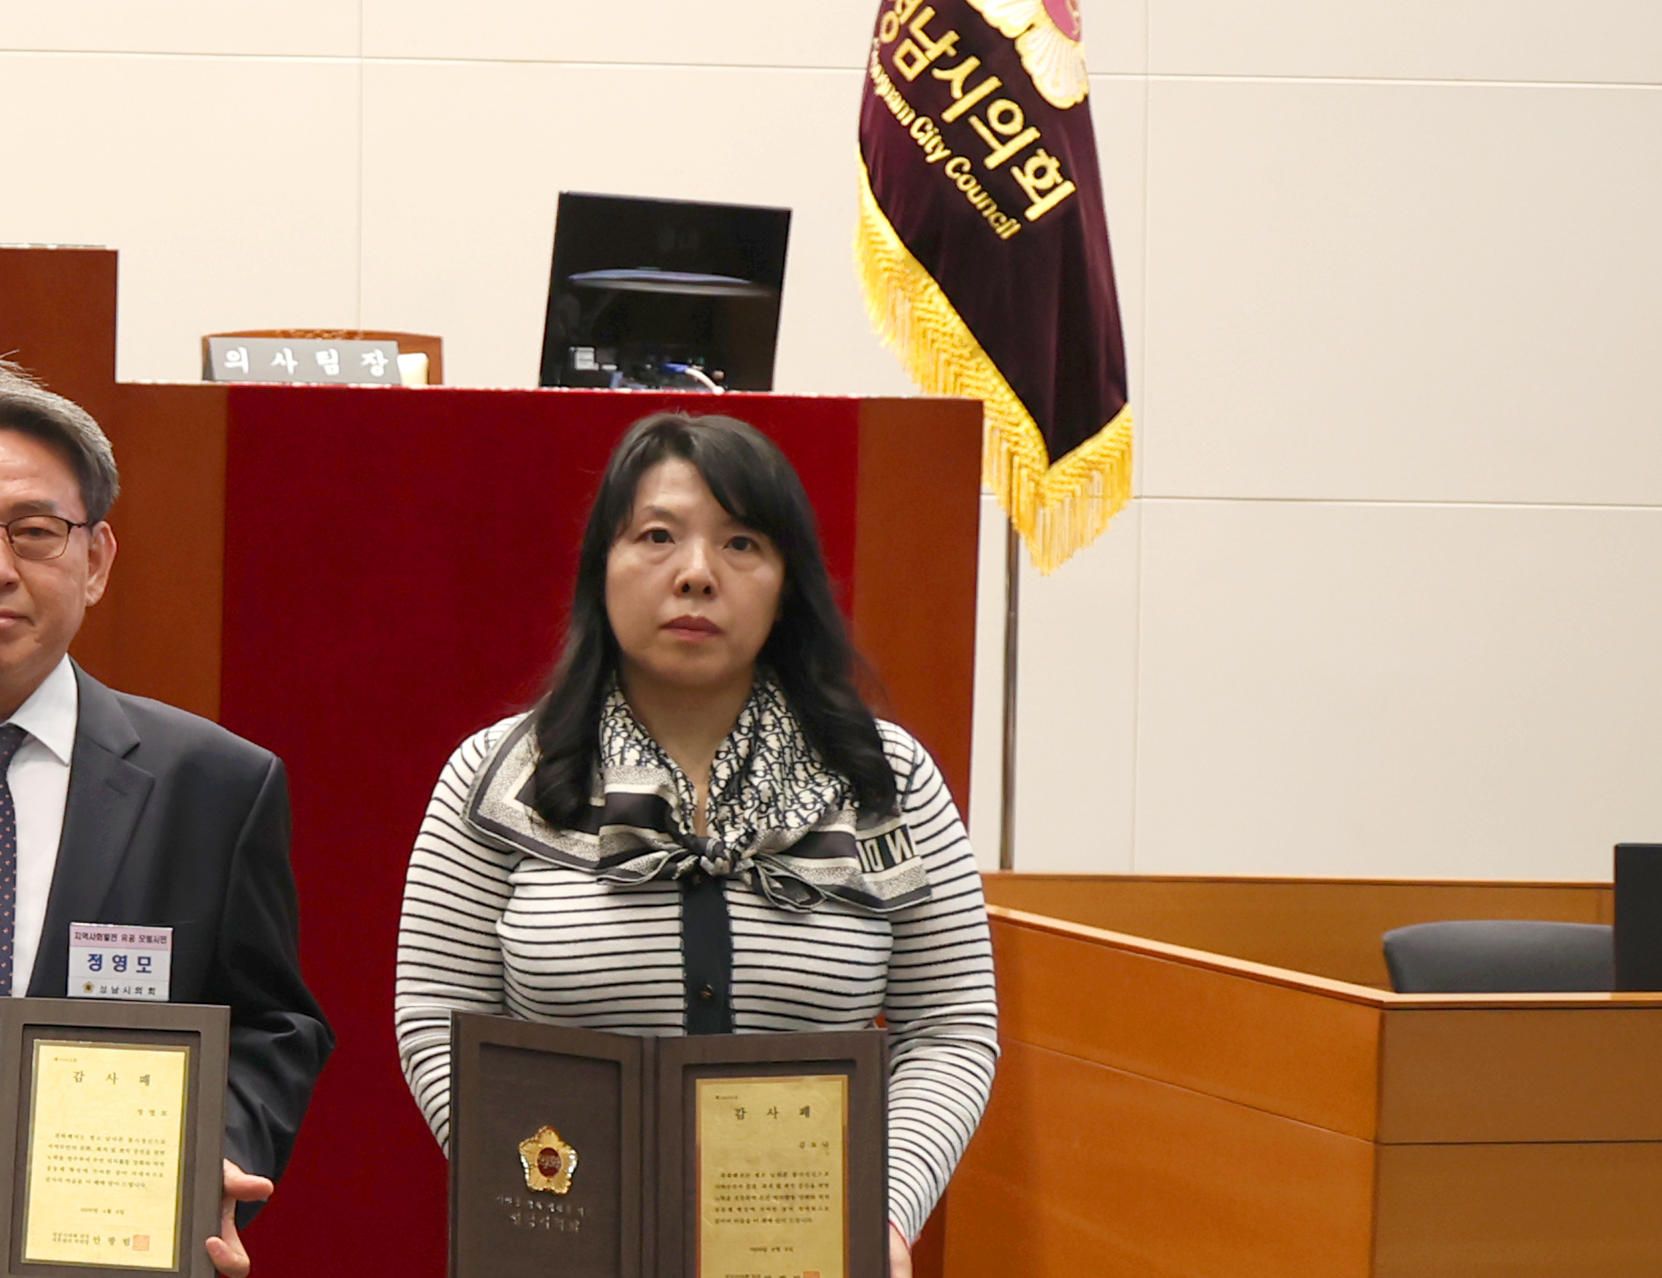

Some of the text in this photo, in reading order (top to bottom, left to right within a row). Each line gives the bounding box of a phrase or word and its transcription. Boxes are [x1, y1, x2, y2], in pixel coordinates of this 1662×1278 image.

[909, 116, 952, 164] City
[944, 156, 1022, 240] Council
[87, 953, 152, 974] 정영모
